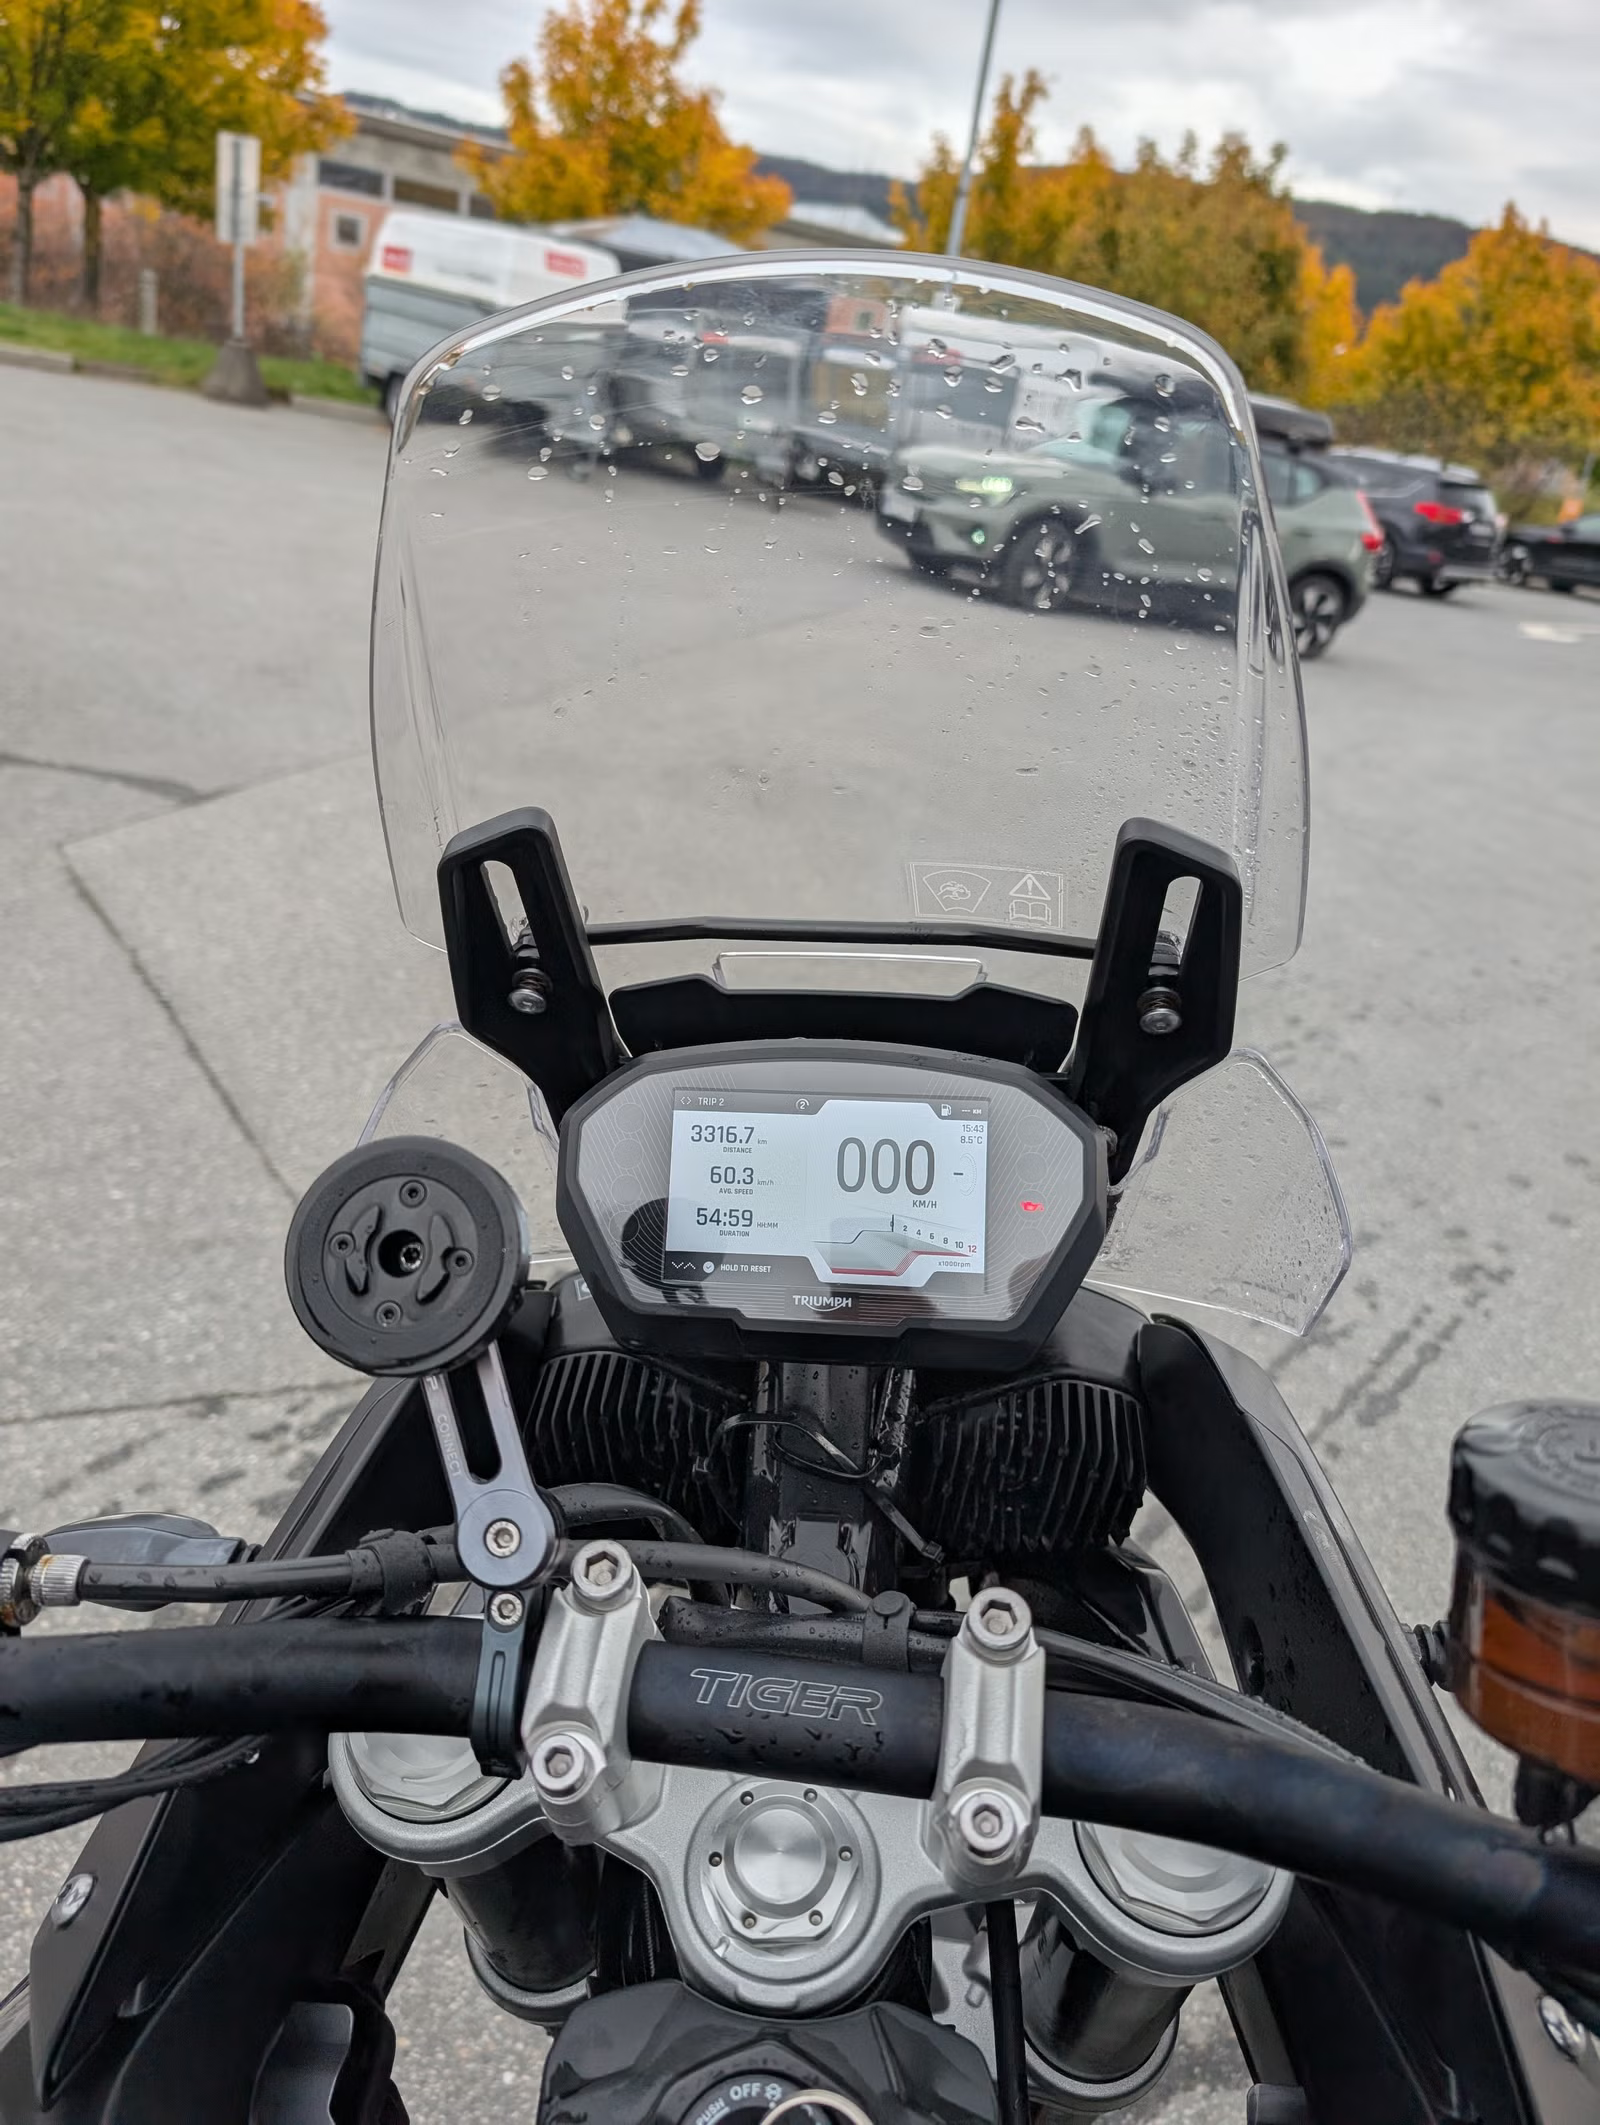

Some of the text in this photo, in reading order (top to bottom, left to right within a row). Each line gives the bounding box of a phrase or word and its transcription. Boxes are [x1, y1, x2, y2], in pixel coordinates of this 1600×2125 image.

[698, 1097, 725, 1106] TRIP 2
[690, 1124, 755, 1144] 3316.7
[962, 1124, 984, 1133] 15:43
[960, 1136, 983, 1144] 8.5°C
[723, 1146, 752, 1154] DISTANCE
[836, 1137, 935, 1196] 000
[710, 1166, 754, 1185] 60.3
[719, 1187, 733, 1195] AVG.
[912, 1200, 937, 1209] KM/H
[696, 1207, 753, 1227] 54:59
[955, 1241, 964, 1249] 10
[968, 1245, 977, 1253] 12
[720, 1264, 738, 1272] HOLD
[750, 1265, 771, 1273] RESET
[792, 1294, 852, 1310] TRIUMPH
[436, 1414, 462, 1477] CONNECT
[690, 1667, 884, 1726] TIGER
[729, 2082, 762, 2101] OFF
[695, 2097, 726, 2125] PUSH
